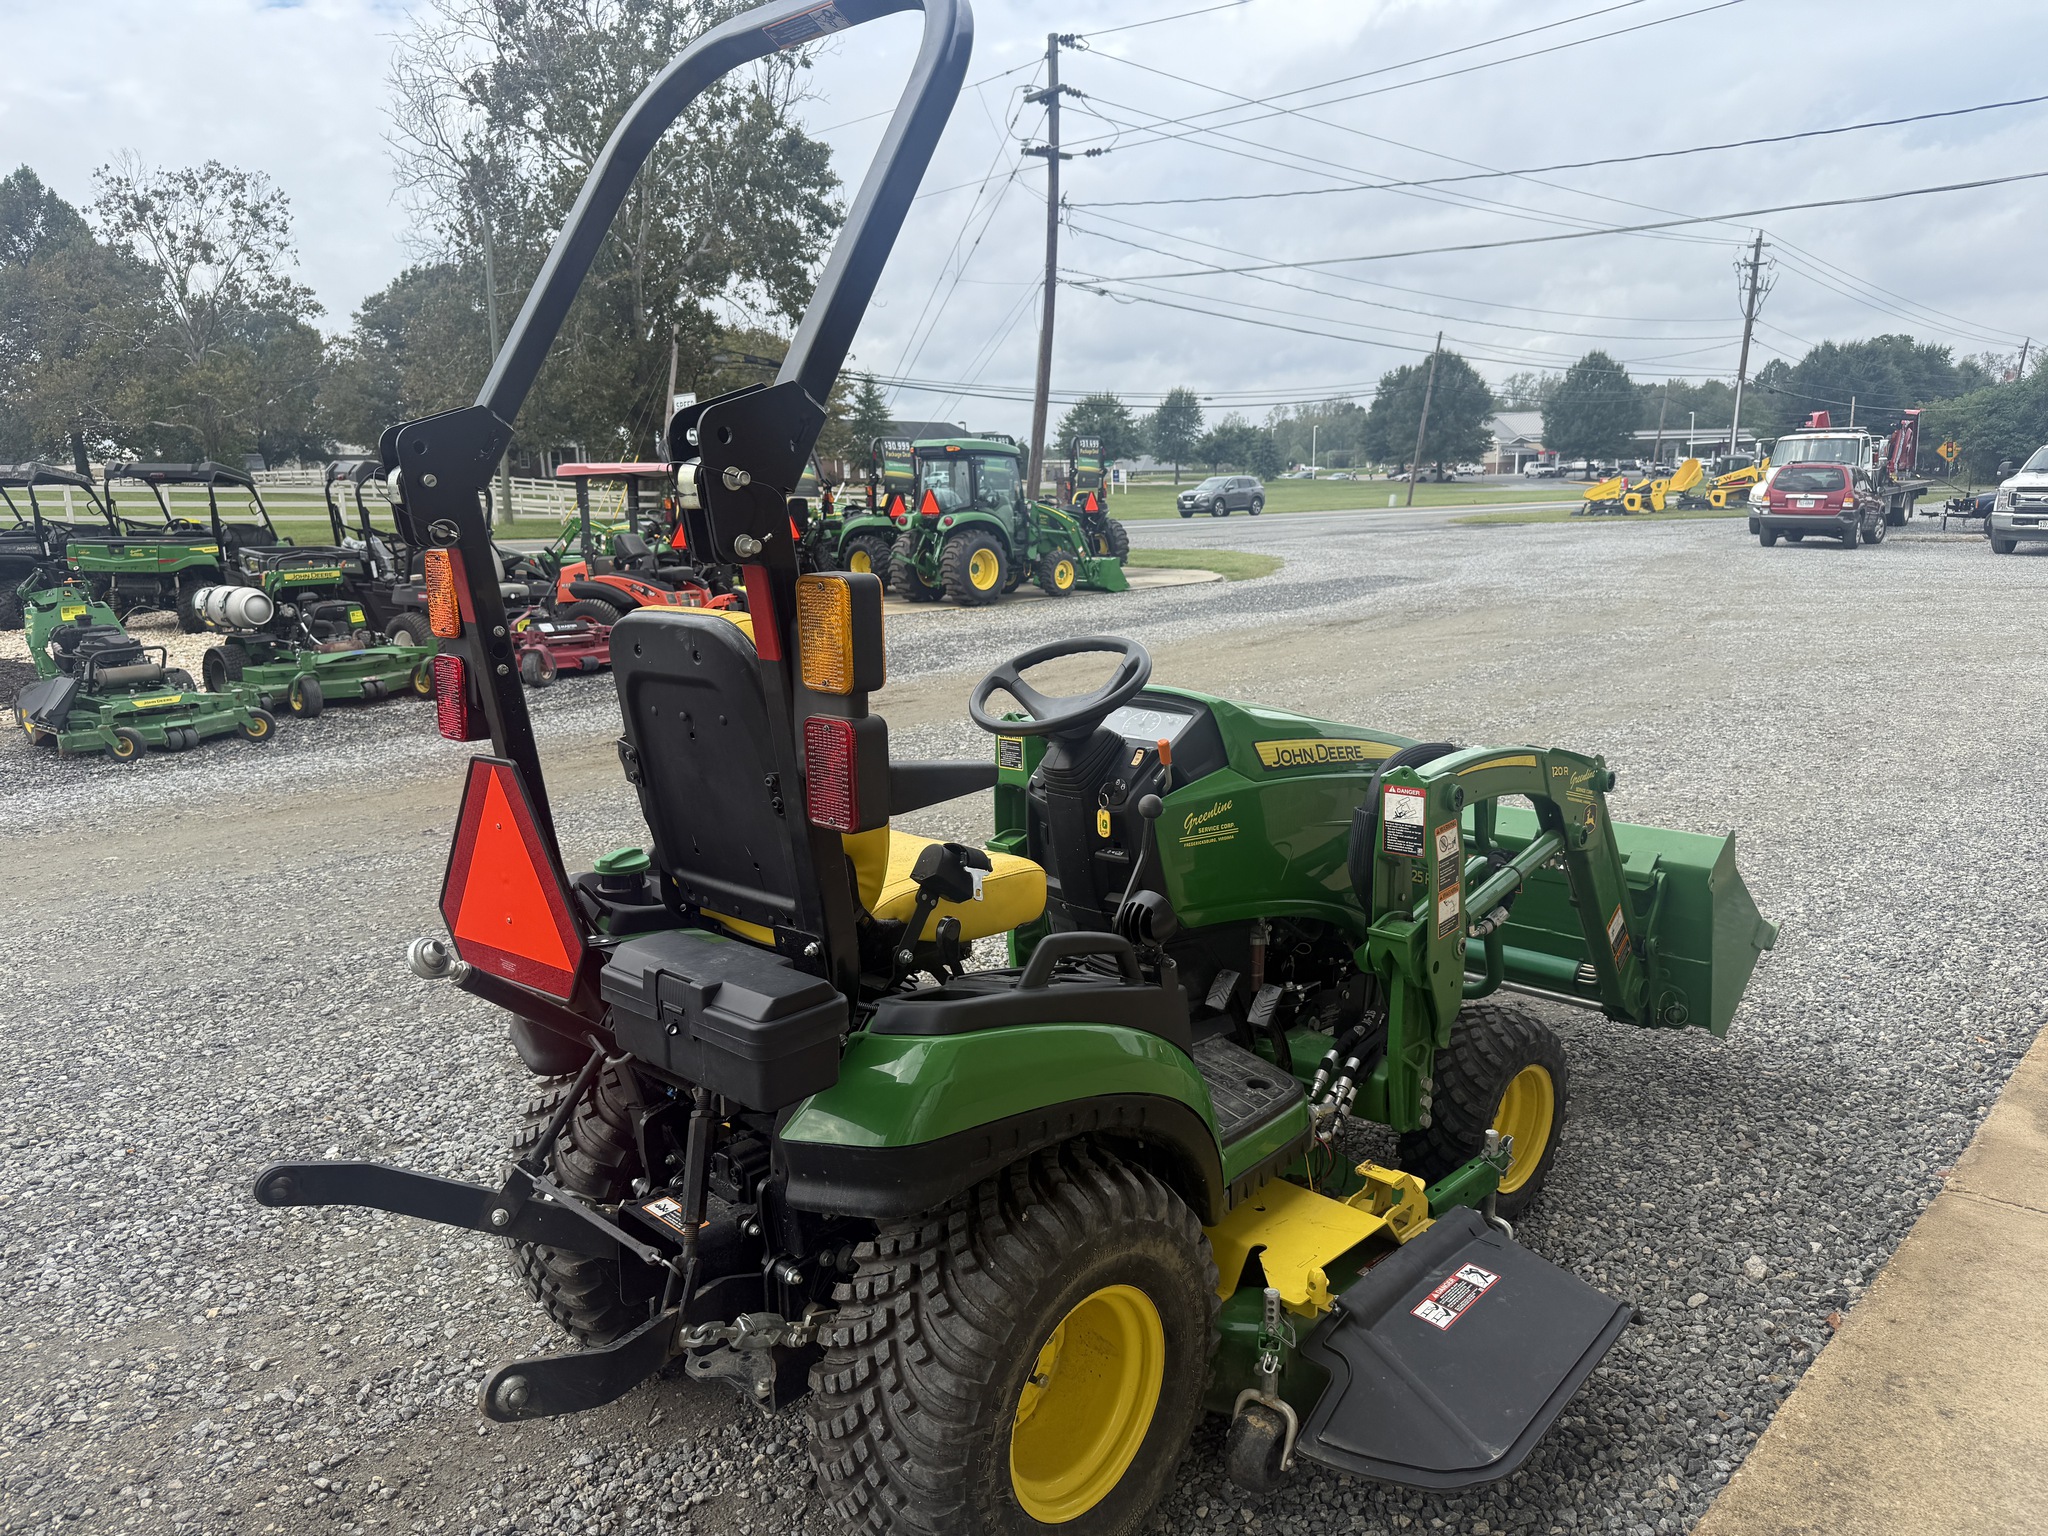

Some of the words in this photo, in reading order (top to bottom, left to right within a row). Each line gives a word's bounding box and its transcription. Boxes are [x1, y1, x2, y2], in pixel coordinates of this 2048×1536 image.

[1273, 748, 1314, 765] JOHN
[1316, 744, 1363, 761] DEERE
[1397, 788, 1420, 796] DANGER
[1184, 800, 1232, 835] Greenline
[1198, 825, 1219, 833] SERVICE
[1436, 1278, 1456, 1295] DANGER
